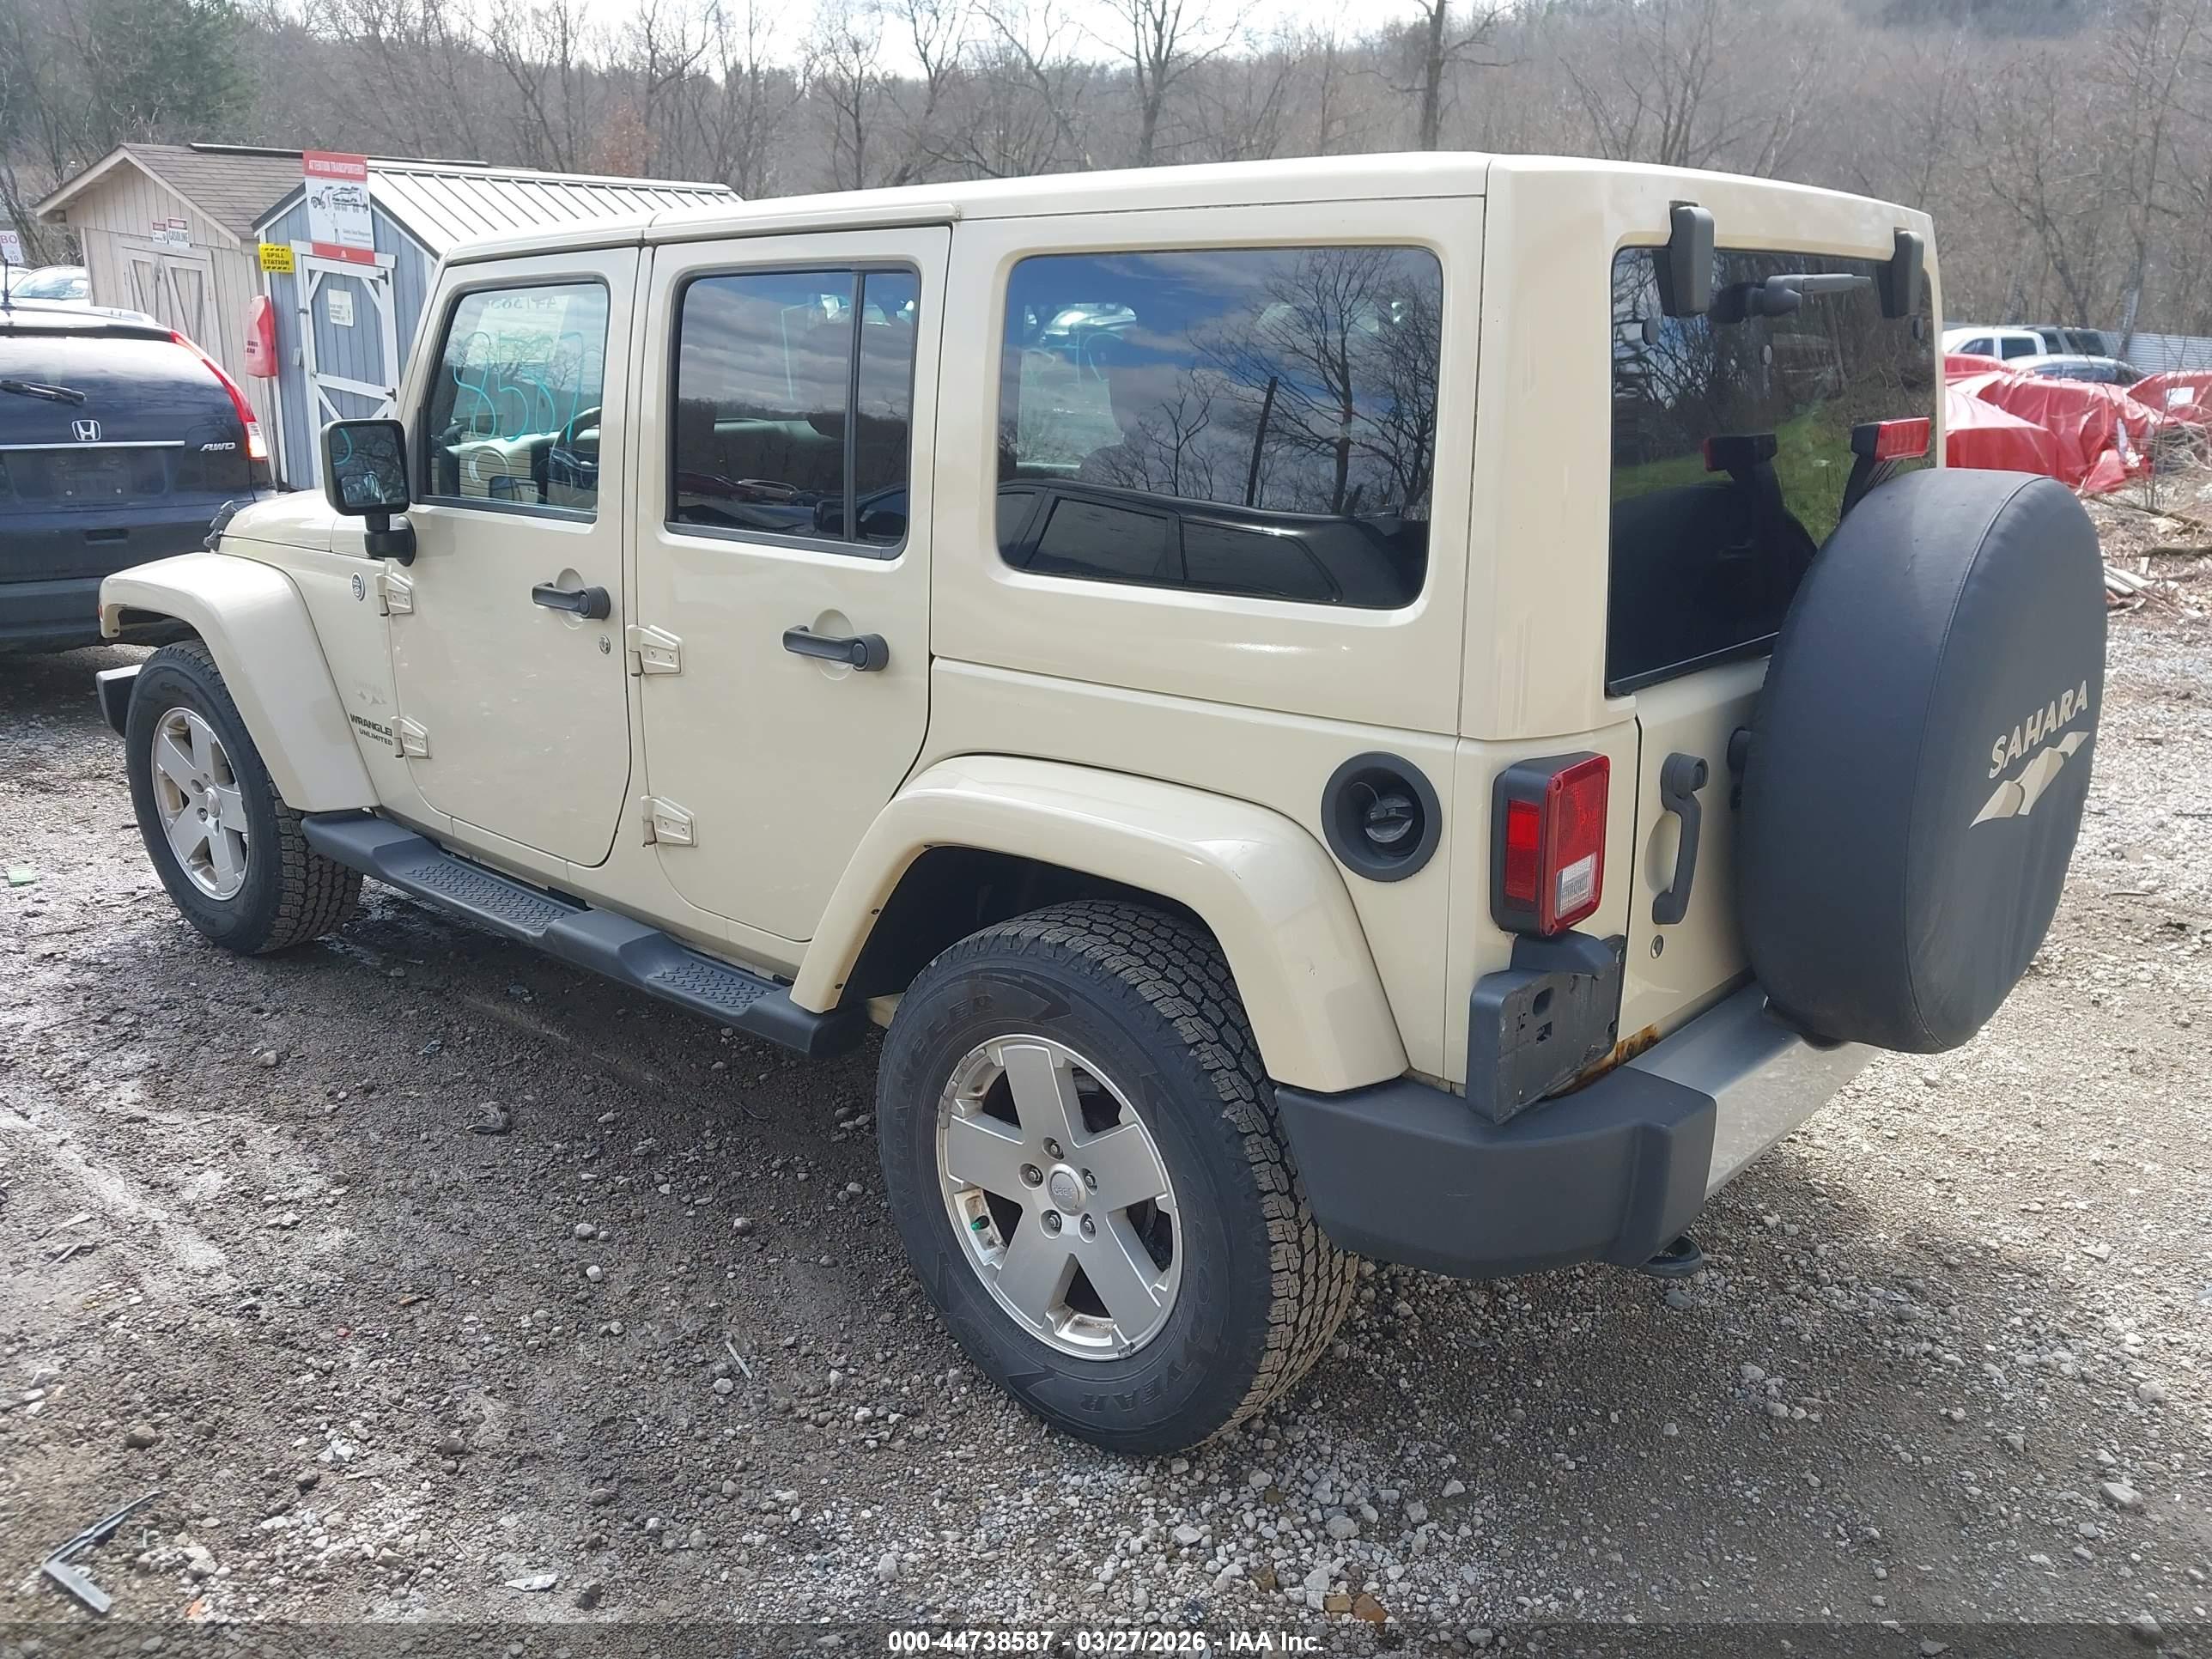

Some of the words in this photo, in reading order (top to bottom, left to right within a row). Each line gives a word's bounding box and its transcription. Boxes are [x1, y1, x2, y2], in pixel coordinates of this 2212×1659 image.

[168, 229, 188, 242] GASOLINE
[199, 441, 236, 453] AWD
[349, 713, 393, 738] WRANGLE
[1988, 679, 2089, 780] SAHARA
[358, 728, 393, 747] UNLIMITED
